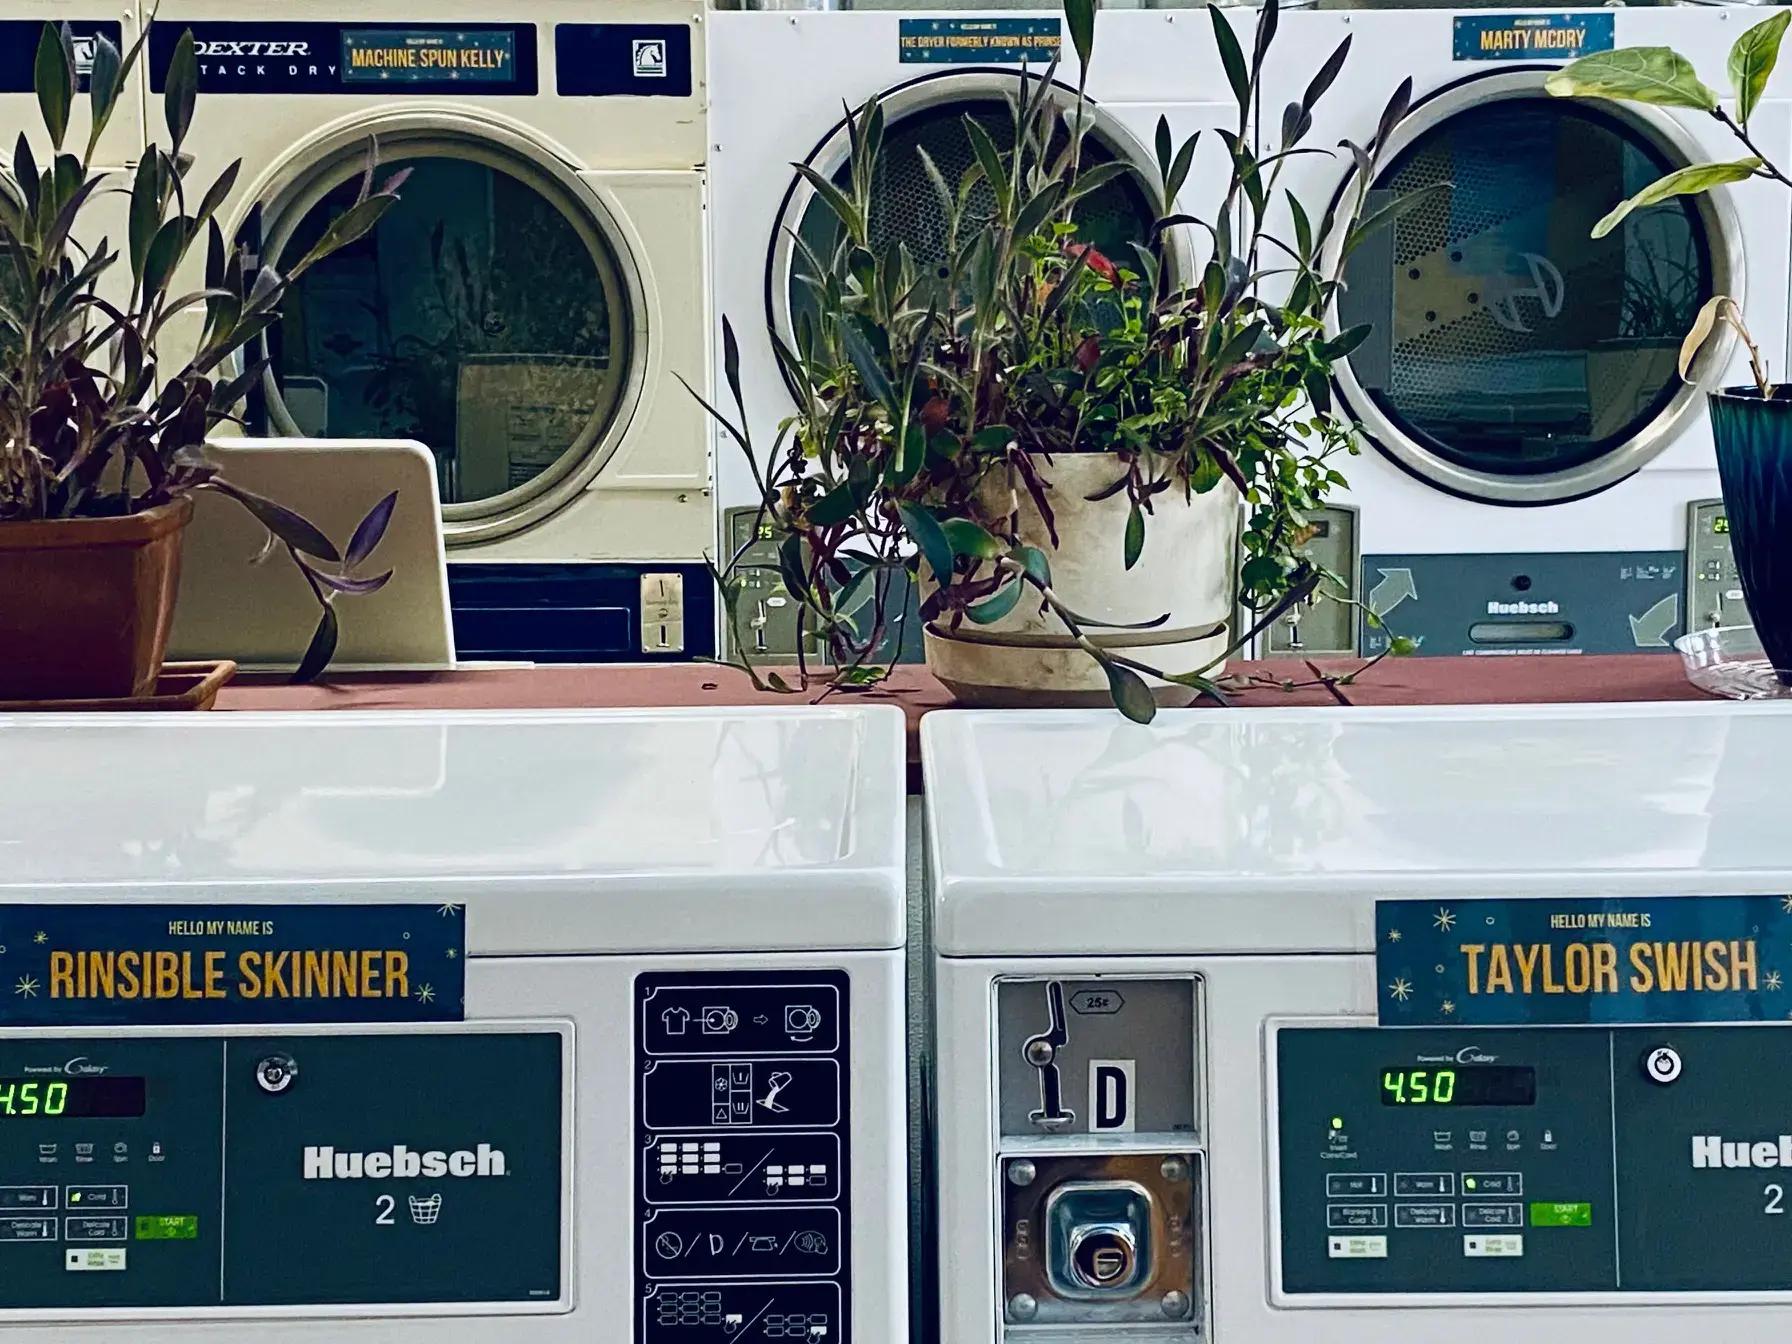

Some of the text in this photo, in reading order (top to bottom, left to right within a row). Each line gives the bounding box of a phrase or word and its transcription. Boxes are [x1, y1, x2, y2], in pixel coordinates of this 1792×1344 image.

[901, 36, 916, 47] THE
[918, 36, 945, 47] DRYER
[990, 36, 1020, 47] KNOWN
[1021, 36, 1032, 47] AS
[1480, 29, 1586, 50] MARTY MCDRY
[200, 65, 265, 75] TACK
[352, 49, 504, 69] MACHINE SPUN KELLY
[1487, 600, 1559, 614] Huebsch
[169, 921, 273, 935] HELLO MY NAME IS
[1551, 913, 1651, 928] HELLO MY NAME IS
[50, 950, 409, 998] RINSIBLE SKINNER
[1460, 940, 1758, 995] TAYLOR SWISH
[1096, 1066, 1126, 1128] D
[1384, 1072, 1455, 1103] 4.50
[304, 1143, 505, 1179] Huebsch
[375, 1195, 395, 1224] 2
[1763, 1184, 1784, 1214] 2
